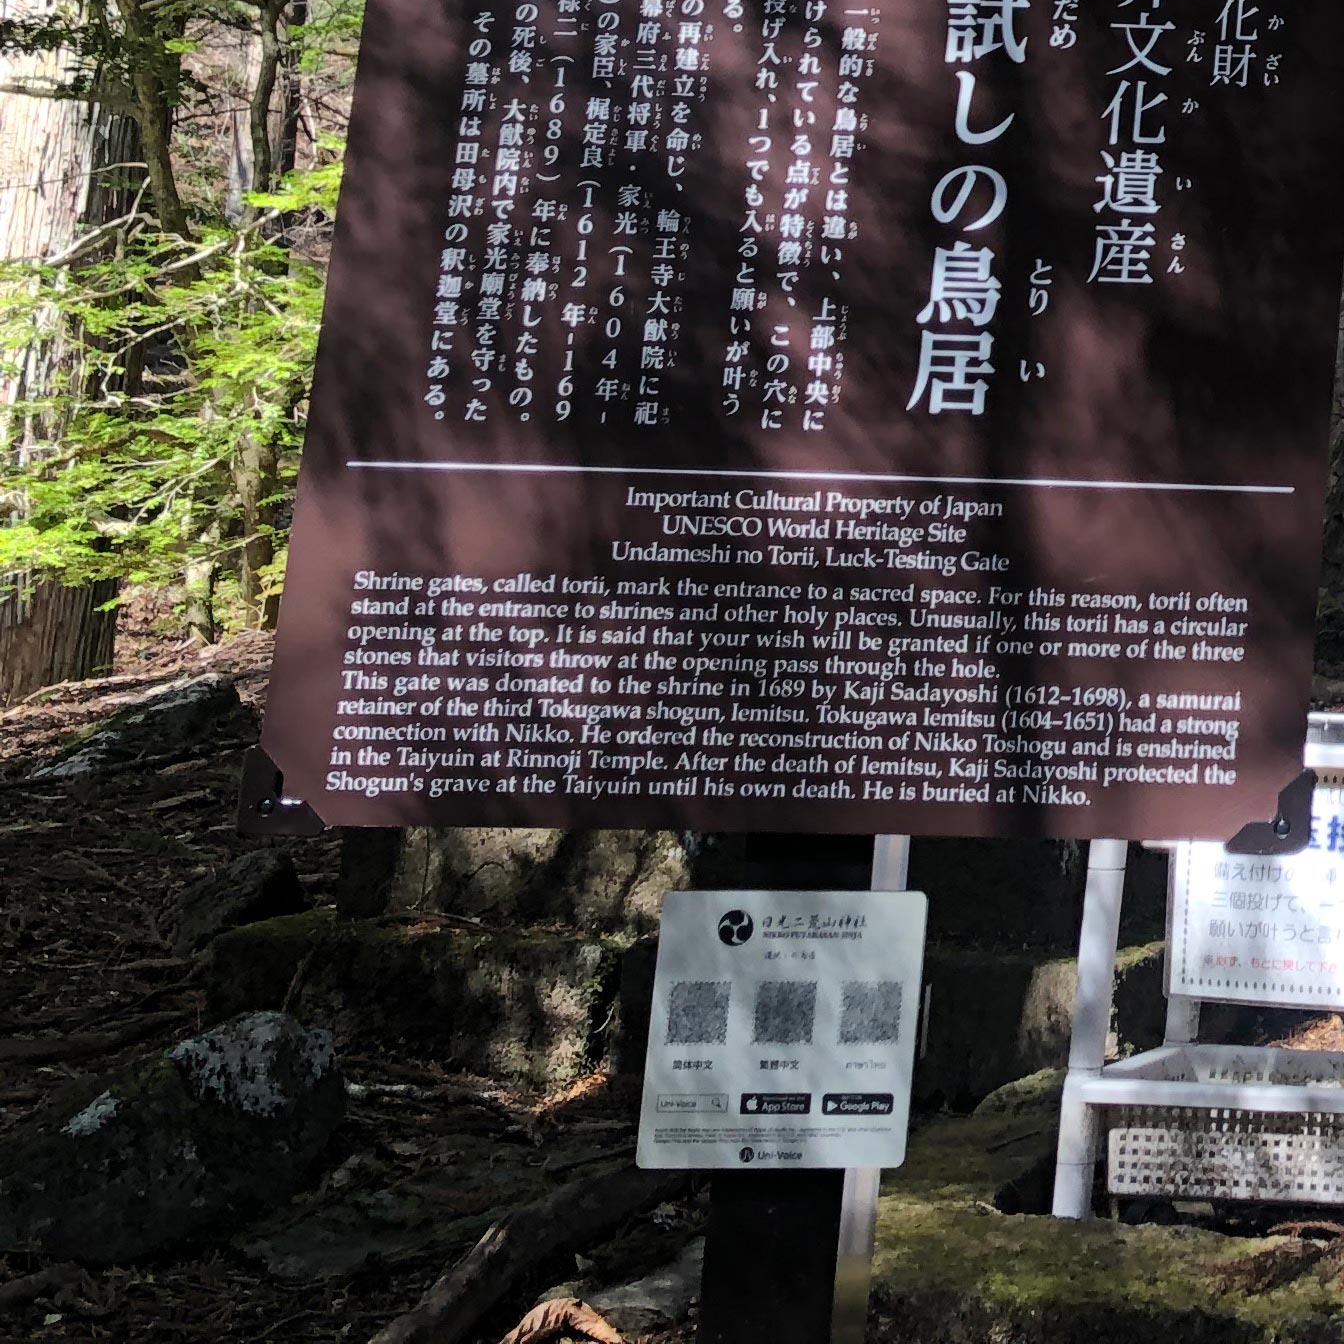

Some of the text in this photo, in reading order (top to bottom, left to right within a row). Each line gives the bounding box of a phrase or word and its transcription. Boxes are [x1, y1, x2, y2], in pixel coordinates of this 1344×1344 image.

[624, 489, 1003, 522] Important Cultural Property Japan
[661, 517, 967, 548] UNESCO World Heritage Site
[611, 543, 1010, 577] Undameshi no Torii, Luck-Testing Gate
[353, 573, 1249, 613] Shrine gates, called torii, mark entrance sacred space. For this reason, torii often
[350, 598, 1249, 637] stand entrance shrines and other holy places. Unusually, this torii has circular
[346, 625, 1245, 662] opening top. It said that your wish will be granted one more three
[342, 647, 1000, 682] stones that visitors throw opening pass through hole.
[340, 672, 1241, 712] This gate was donated shrine 1689 Kaji Sadayoshi (1612–1698), samurai
[336, 697, 1240, 740] retainer the third Tokugawa shogun, Iemitsu. Tokugawa Iemitsu (1604–1651) had strong
[332, 723, 1236, 760] connection with Nikko. He ordered the reconstruction Nikko Toshogu and enshrined
[356, 748, 1237, 787] the Taiyuin Rinnoji Temple. After the death Iemitsu, Kaji Sadayoshi protected the
[324, 772, 1091, 806] Shogun's grave the Taiyuin until his own death. He buried Nikko.
[761, 1101, 805, 1113] App Store
[840, 1101, 890, 1113] Google Play
[757, 1151, 803, 1161] Uni-Voice
